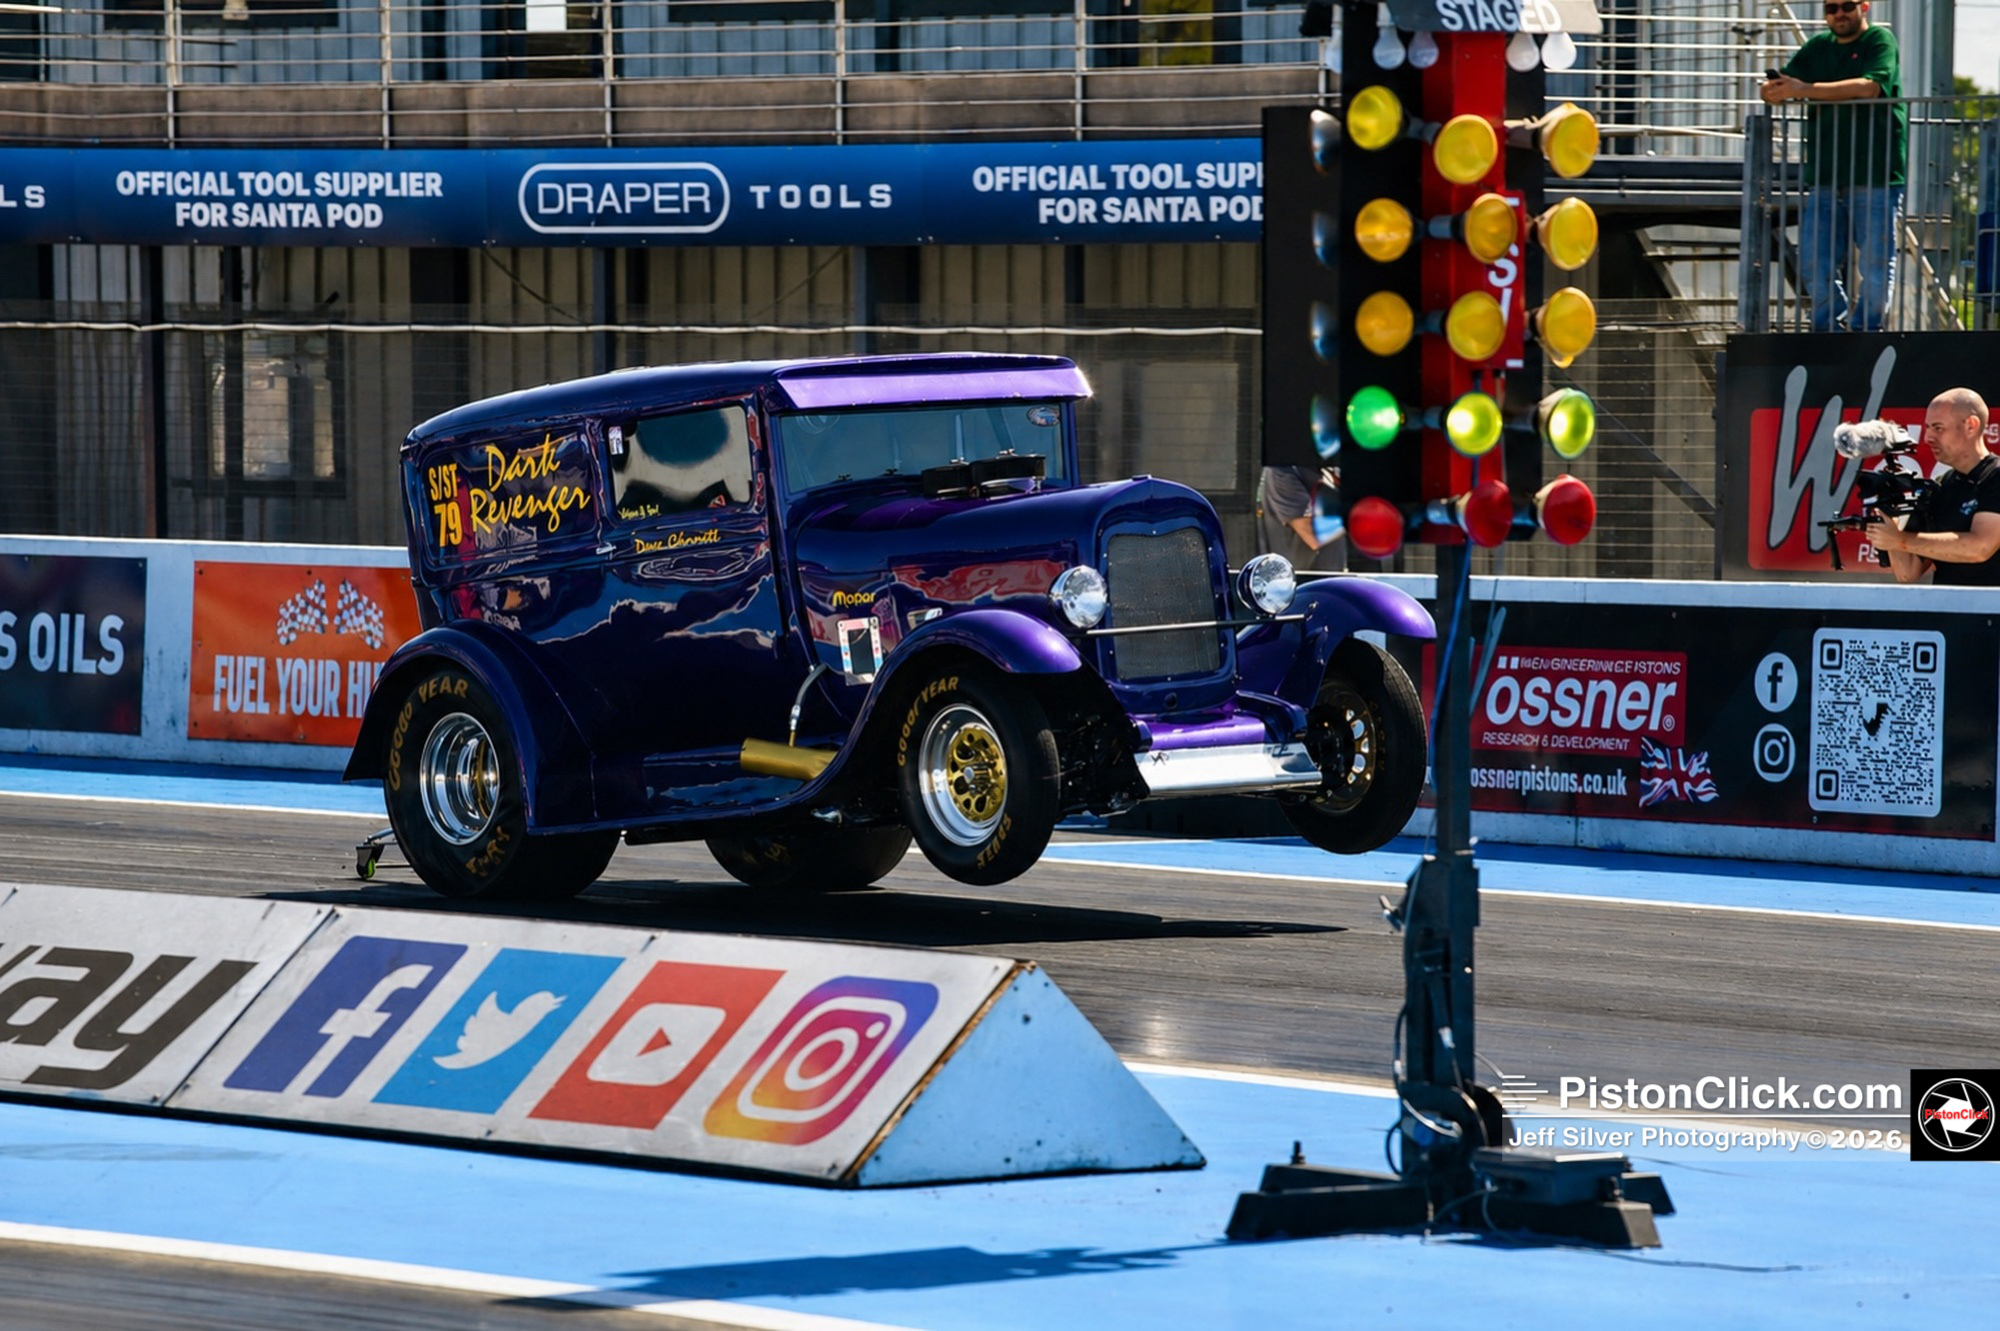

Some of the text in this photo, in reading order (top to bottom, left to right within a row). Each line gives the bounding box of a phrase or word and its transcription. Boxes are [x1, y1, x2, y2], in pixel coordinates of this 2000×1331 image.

[1436, 0, 1561, 32] STAGED
[116, 171, 443, 198] OFFICIAL TOOL SUPPLIER
[972, 163, 1105, 192] OFFICIAL
[1111, 164, 1191, 190] TOOL
[537, 183, 711, 214] DRAPER
[749, 183, 893, 209] TOOLS
[1039, 198, 1097, 224] FOR
[1103, 195, 1204, 223] SANTA
[176, 202, 383, 229] FOR SANTA POD
[485, 433, 560, 492] Dark
[428, 463, 458, 501] S/ST
[434, 501, 462, 548] 79
[470, 485, 591, 533] Revenger
[832, 590, 876, 608] Mopar
[29, 611, 125, 675] OILS
[213, 654, 271, 715] FUEL
[275, 657, 341, 718] YOUR
[1484, 674, 1678, 733] ossner
[1482, 731, 1540, 747] RESEARCH
[1551, 735, 1631, 751] DEVELOPMENT
[1470, 763, 1628, 796] ossnerpistons.co.uk
[0, 943, 260, 1091] ay
